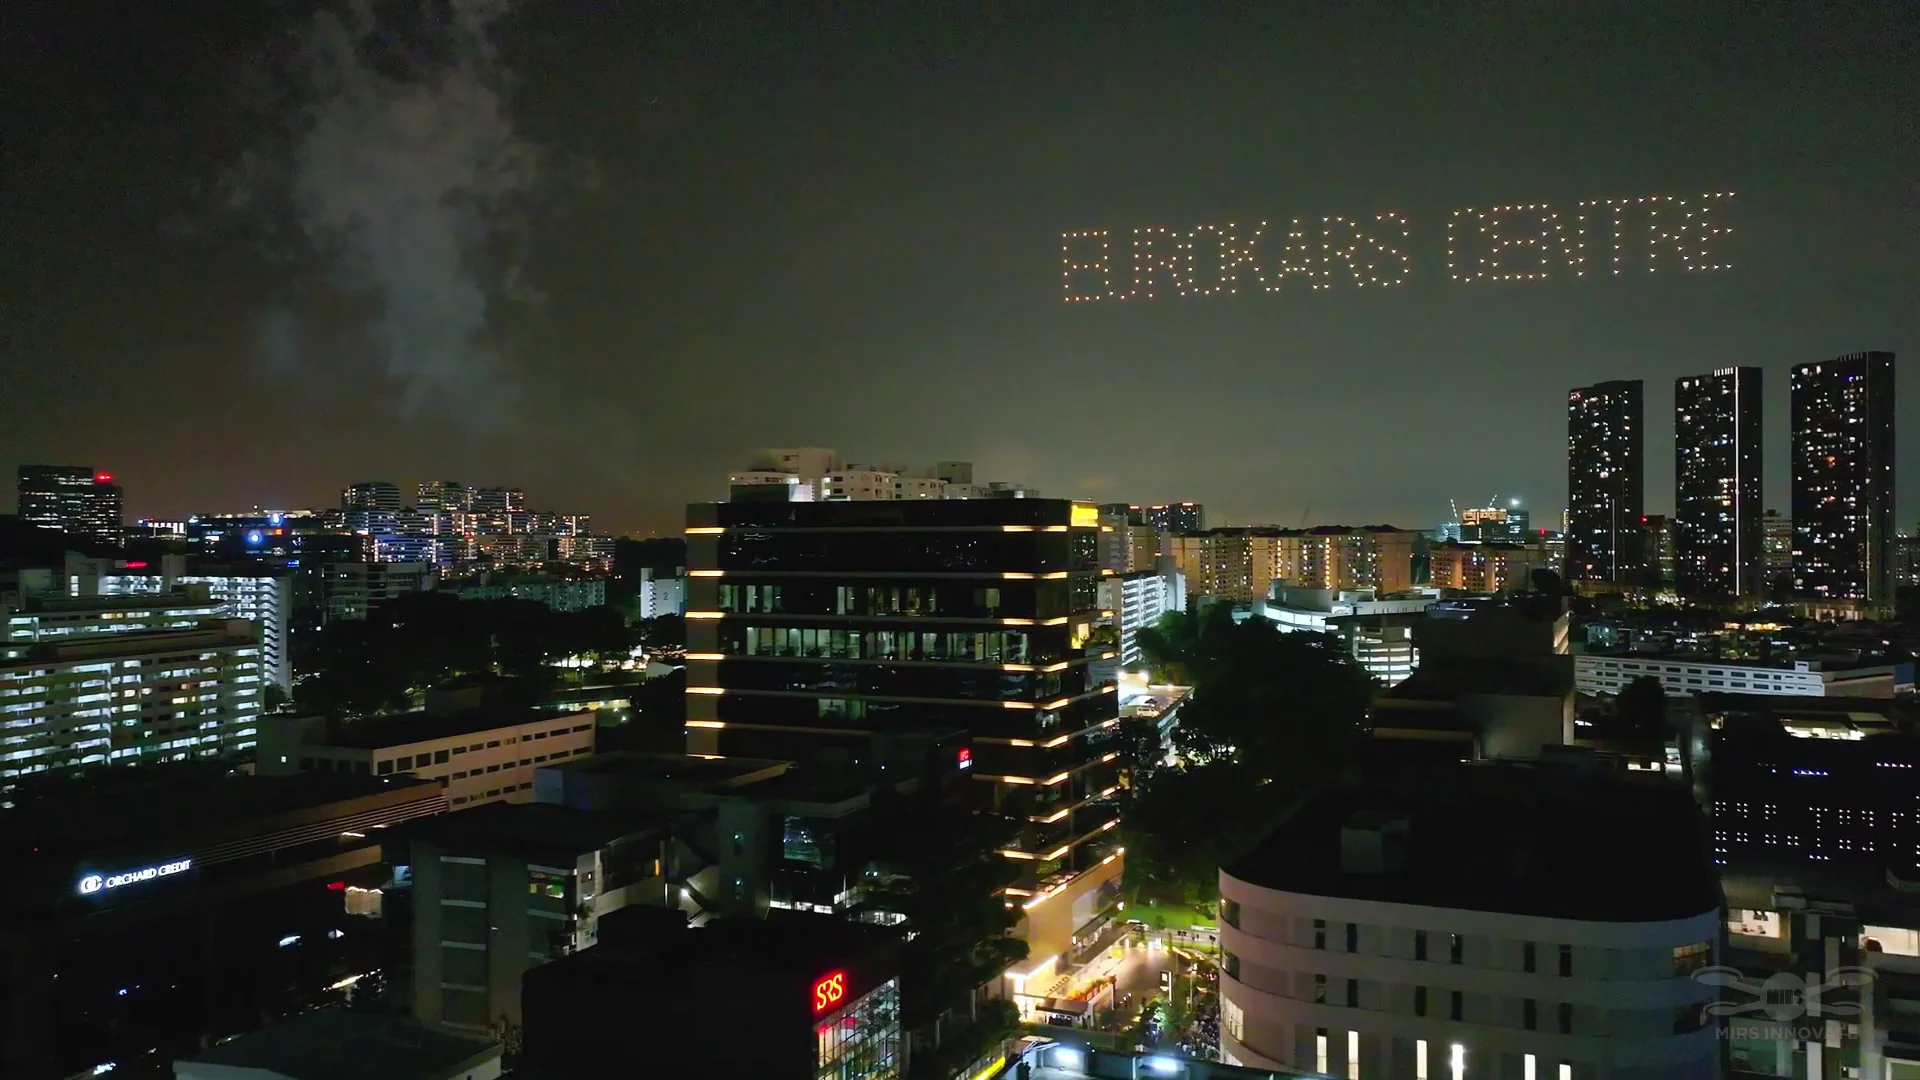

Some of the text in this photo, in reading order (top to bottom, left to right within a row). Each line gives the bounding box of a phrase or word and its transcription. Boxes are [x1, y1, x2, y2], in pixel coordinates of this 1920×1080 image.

[1062, 192, 1735, 302] EUROKARS CENTRE
[106, 868, 157, 888] ORCHARD
[158, 859, 191, 876] CREDIT
